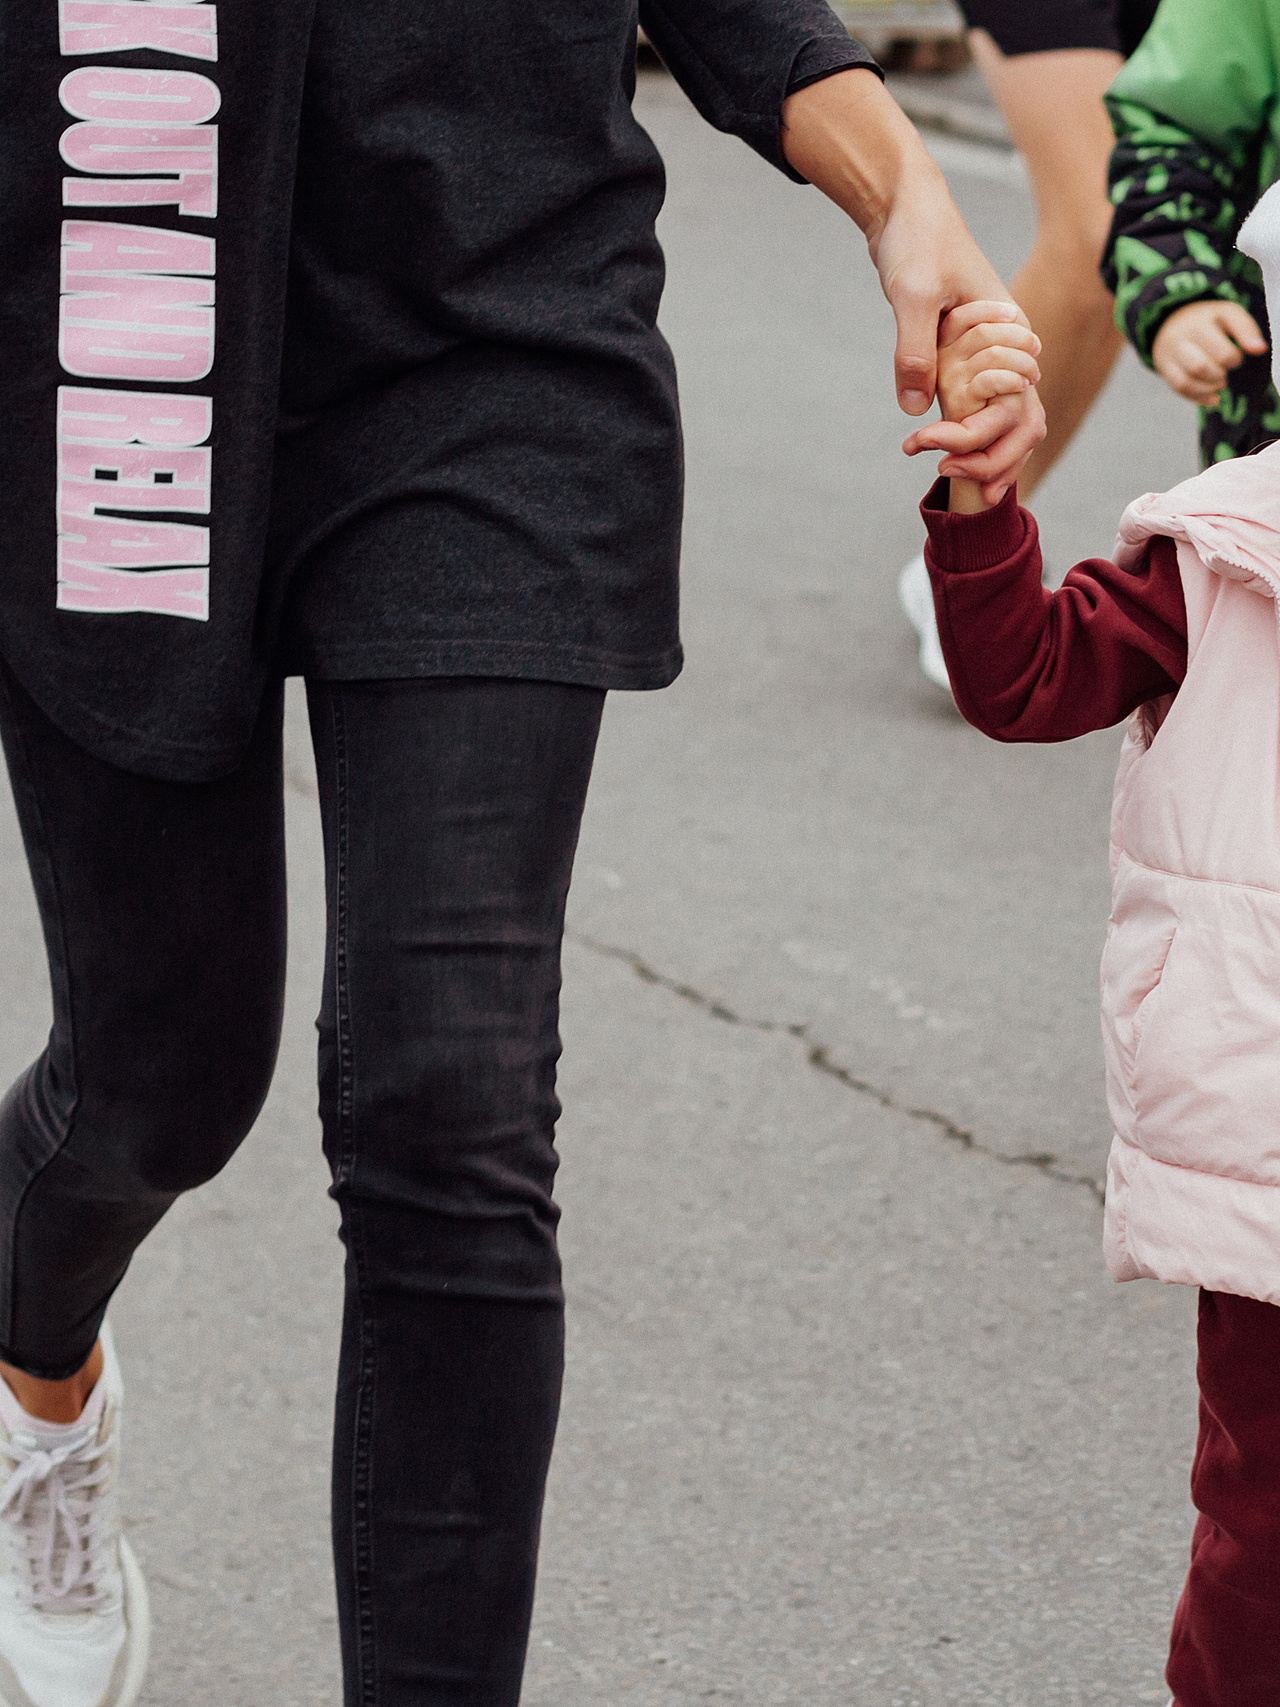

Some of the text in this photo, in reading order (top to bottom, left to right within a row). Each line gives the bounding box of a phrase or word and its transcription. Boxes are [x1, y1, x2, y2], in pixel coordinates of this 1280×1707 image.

[56, 0, 222, 623] K OUT AND RELAX
